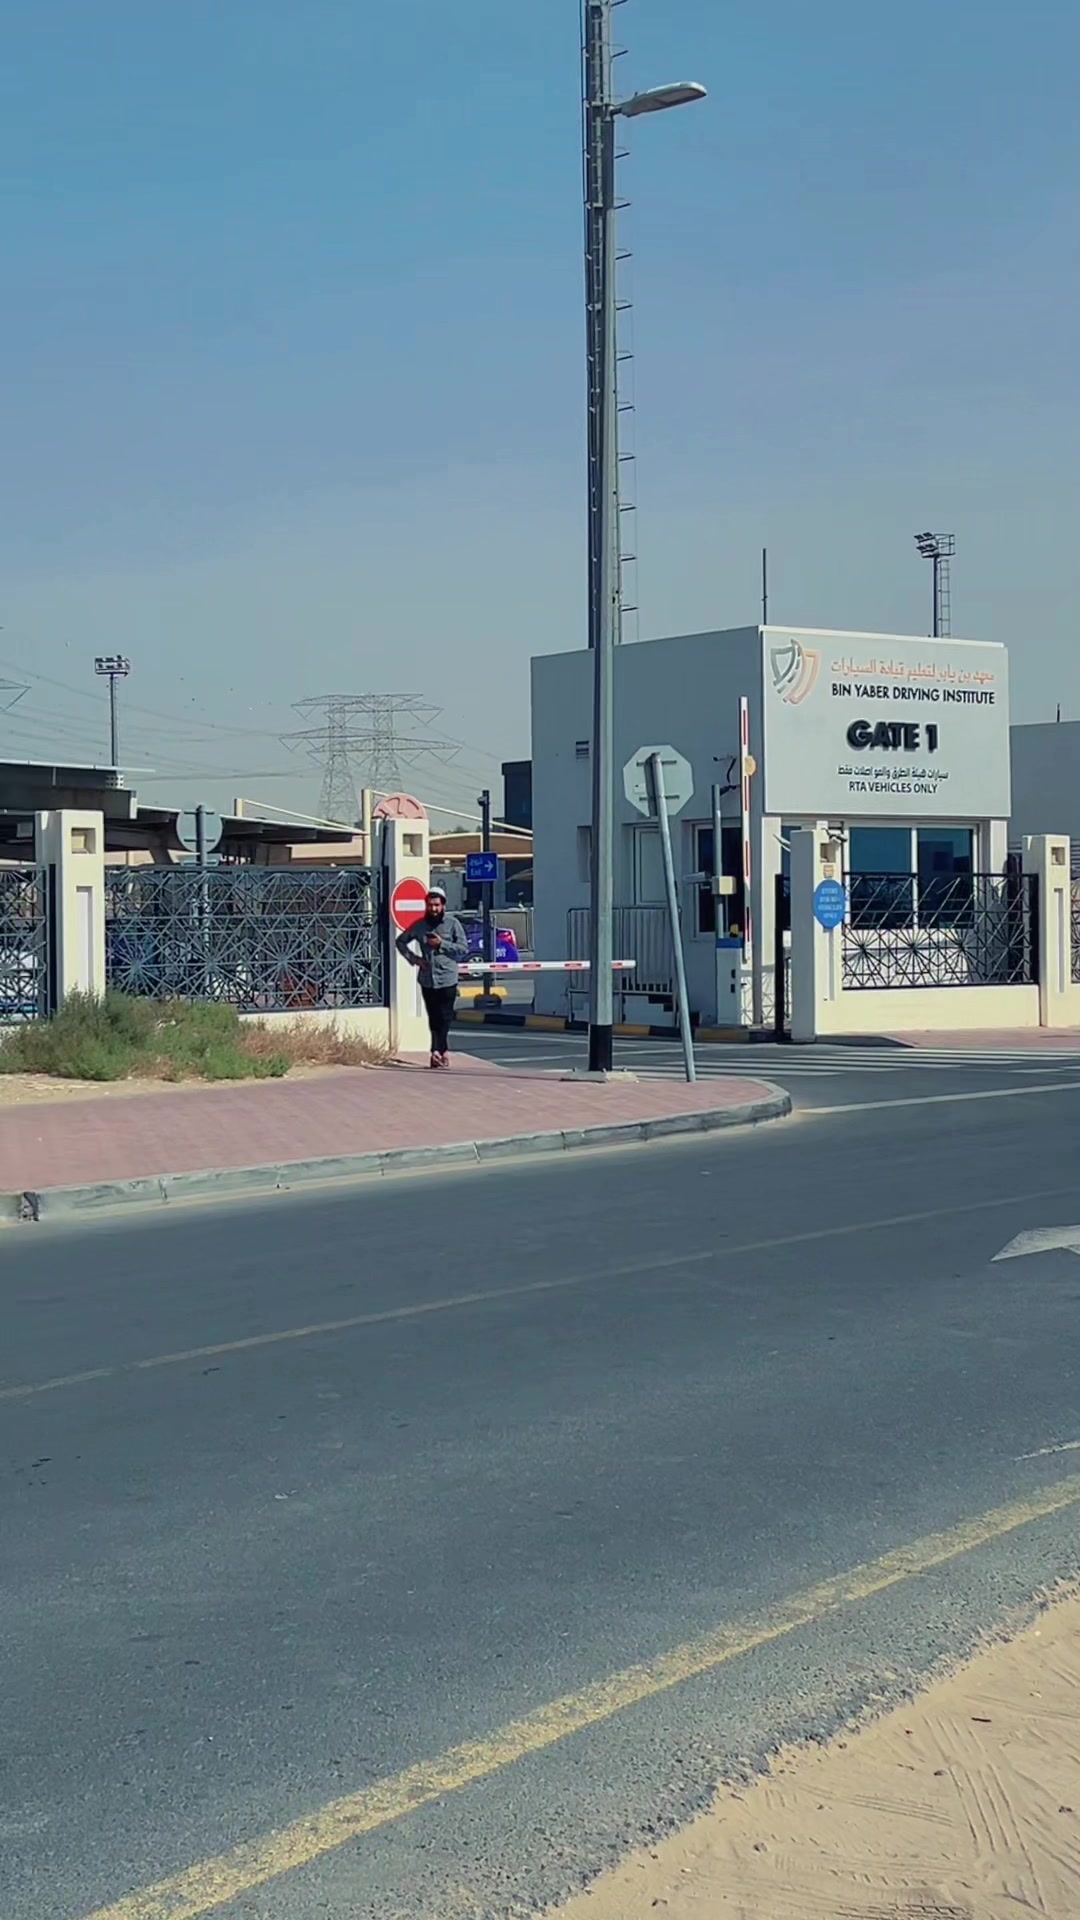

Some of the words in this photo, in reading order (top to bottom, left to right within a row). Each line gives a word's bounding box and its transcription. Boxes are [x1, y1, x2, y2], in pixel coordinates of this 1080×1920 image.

[831, 657, 876, 677] السيارات
[879, 659, 904, 679] قيادة
[907, 662, 936, 682] لتعليم
[958, 669, 971, 684] بن
[973, 670, 995, 685] معهد
[831, 683, 851, 697] BIN
[854, 684, 890, 700] YABER
[892, 686, 940, 702] DRIVING
[943, 689, 995, 705] INSTITUTE
[846, 719, 921, 752] GATE
[925, 723, 938, 753] 1
[838, 764, 853, 776] فقط
[892, 766, 910, 780] الطرق
[927, 769, 949, 782] سيارات
[849, 781, 867, 792] RTA
[868, 782, 912, 794] VEHICLES
[913, 783, 938, 794] ONLY
